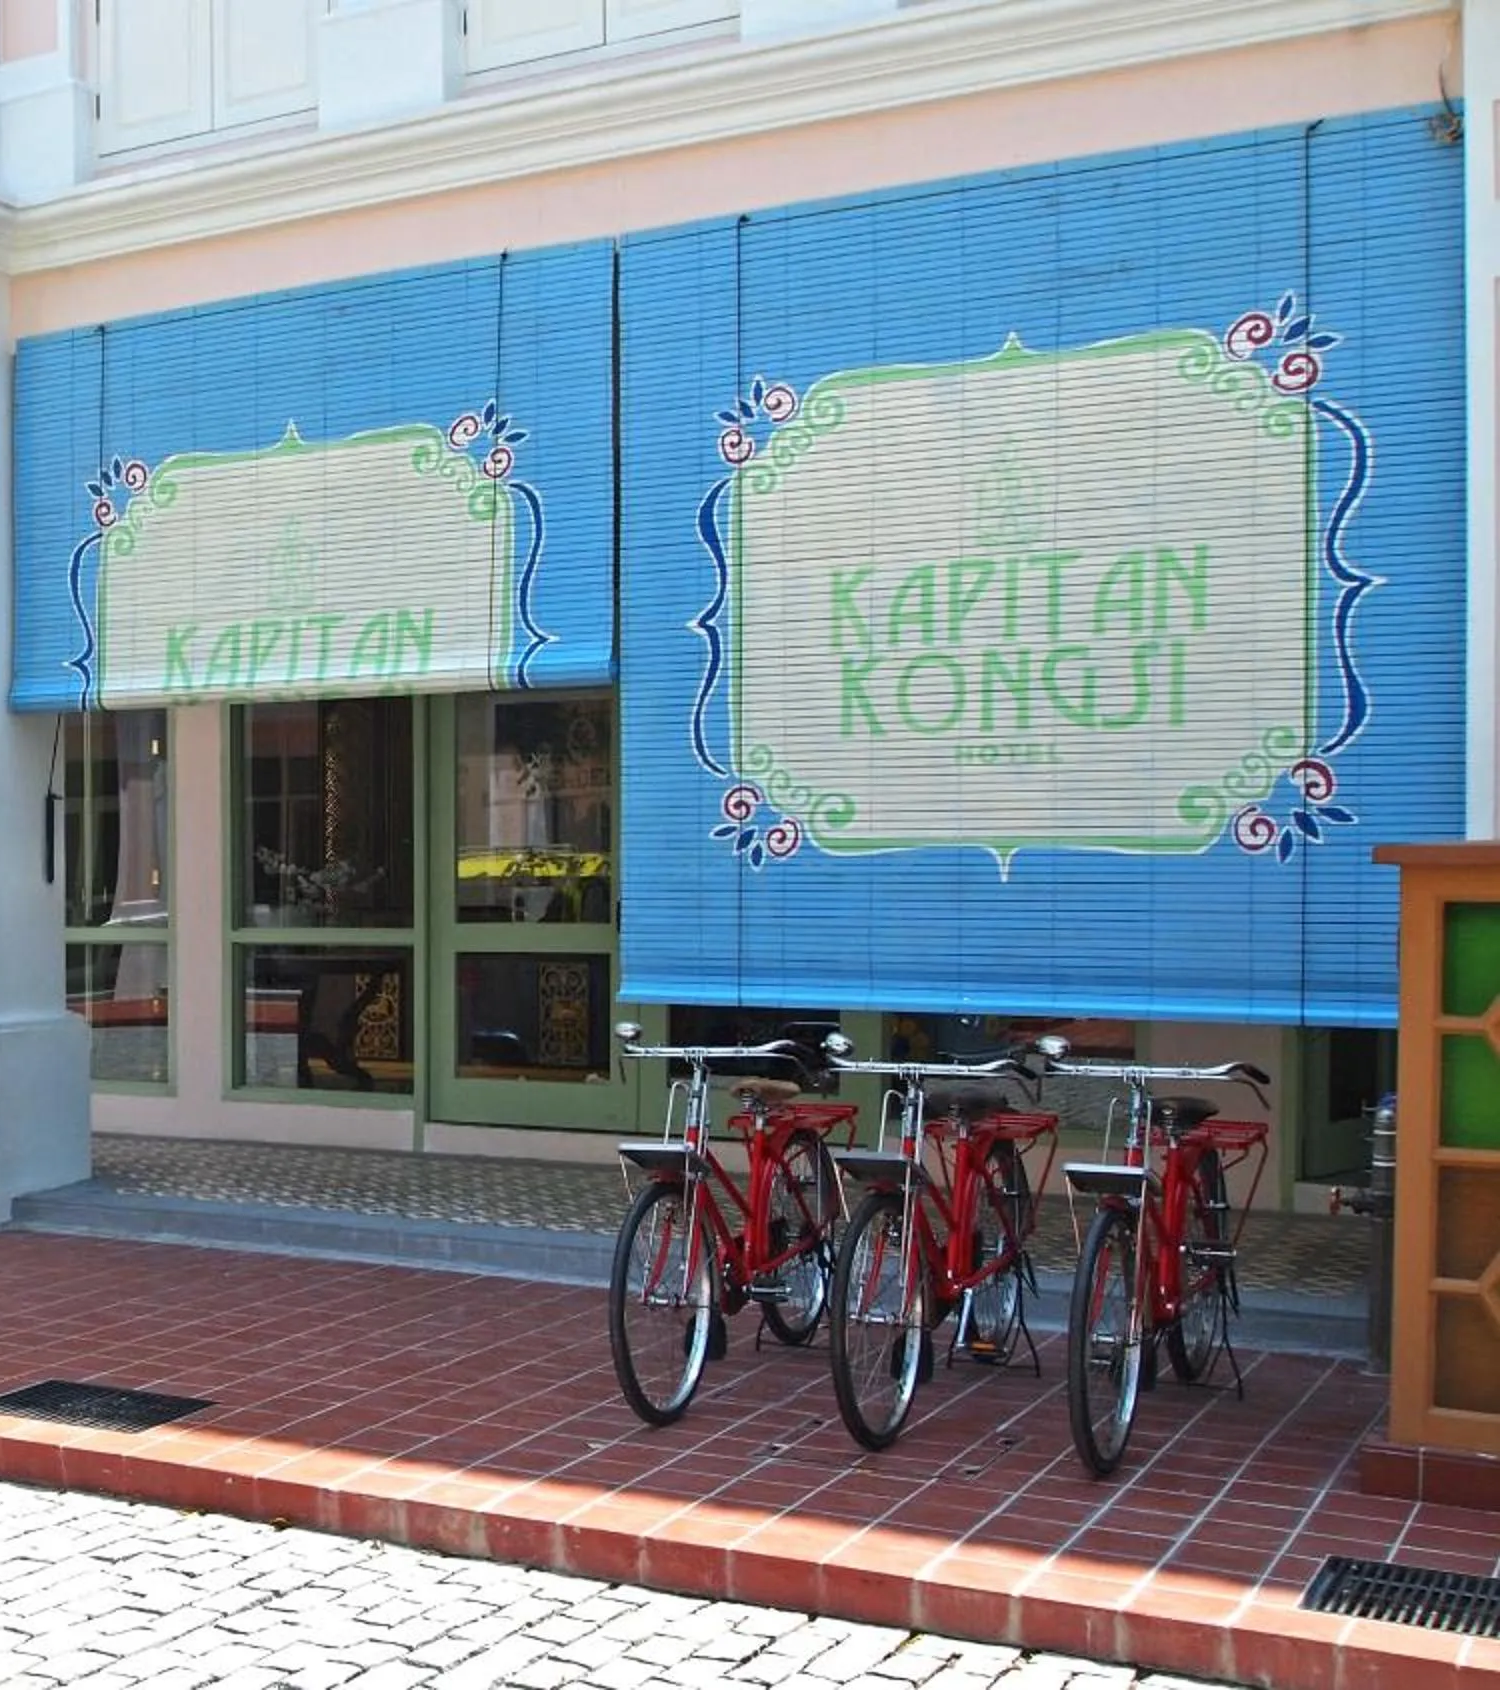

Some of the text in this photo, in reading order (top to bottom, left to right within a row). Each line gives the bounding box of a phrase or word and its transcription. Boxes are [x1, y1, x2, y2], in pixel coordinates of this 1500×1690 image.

[828, 544, 1208, 652] KAPITAN
[163, 607, 433, 691] KAPITAN
[839, 637, 1186, 738] KONGSI
[954, 742, 1063, 767] HOTEL
